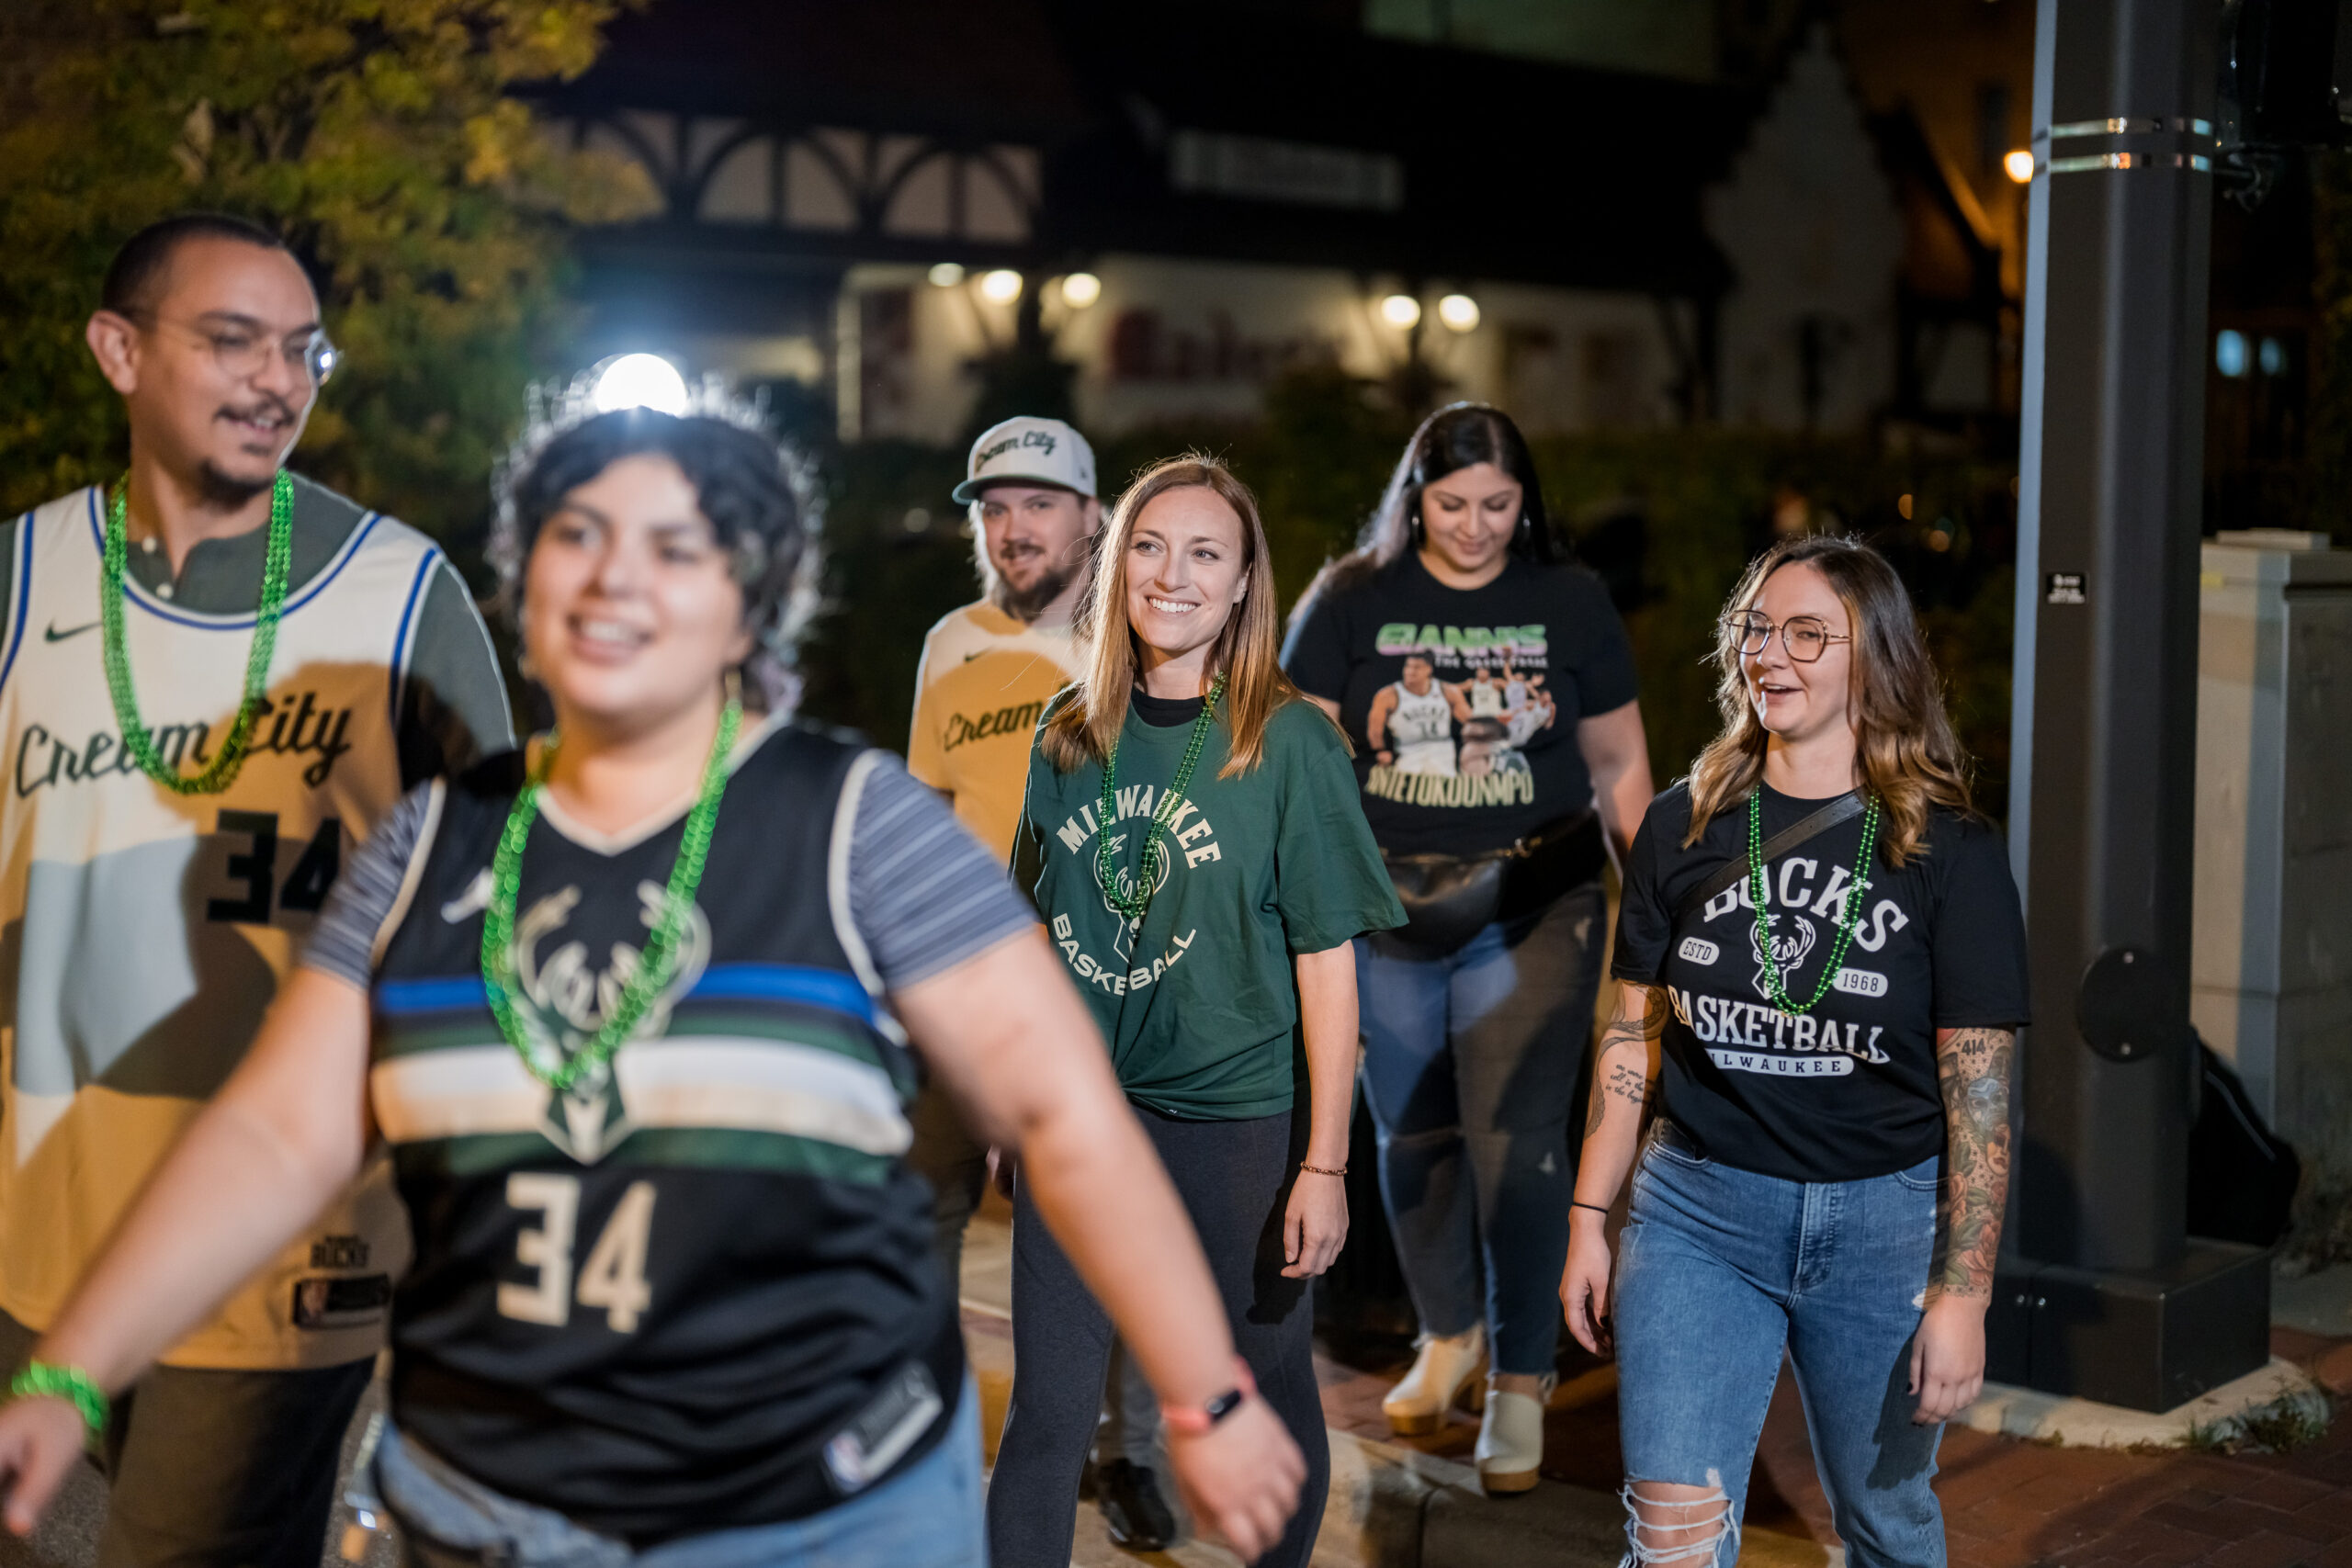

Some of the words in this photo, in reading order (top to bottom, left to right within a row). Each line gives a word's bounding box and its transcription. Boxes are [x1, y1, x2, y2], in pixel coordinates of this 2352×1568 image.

[944, 700, 1044, 752] Cream
[207, 808, 341, 924] 34
[1703, 856, 1909, 953] BUCKS
[1053, 913, 1196, 996] BASKEBALL
[1683, 941, 1713, 961] ESTD
[1842, 973, 1879, 993] 1968
[1668, 985, 1891, 1065] BASKETBALL
[1711, 1054, 1841, 1073] ILWAUKEE
[1961, 1038, 1985, 1055] 414
[497, 1172, 658, 1335] 34
